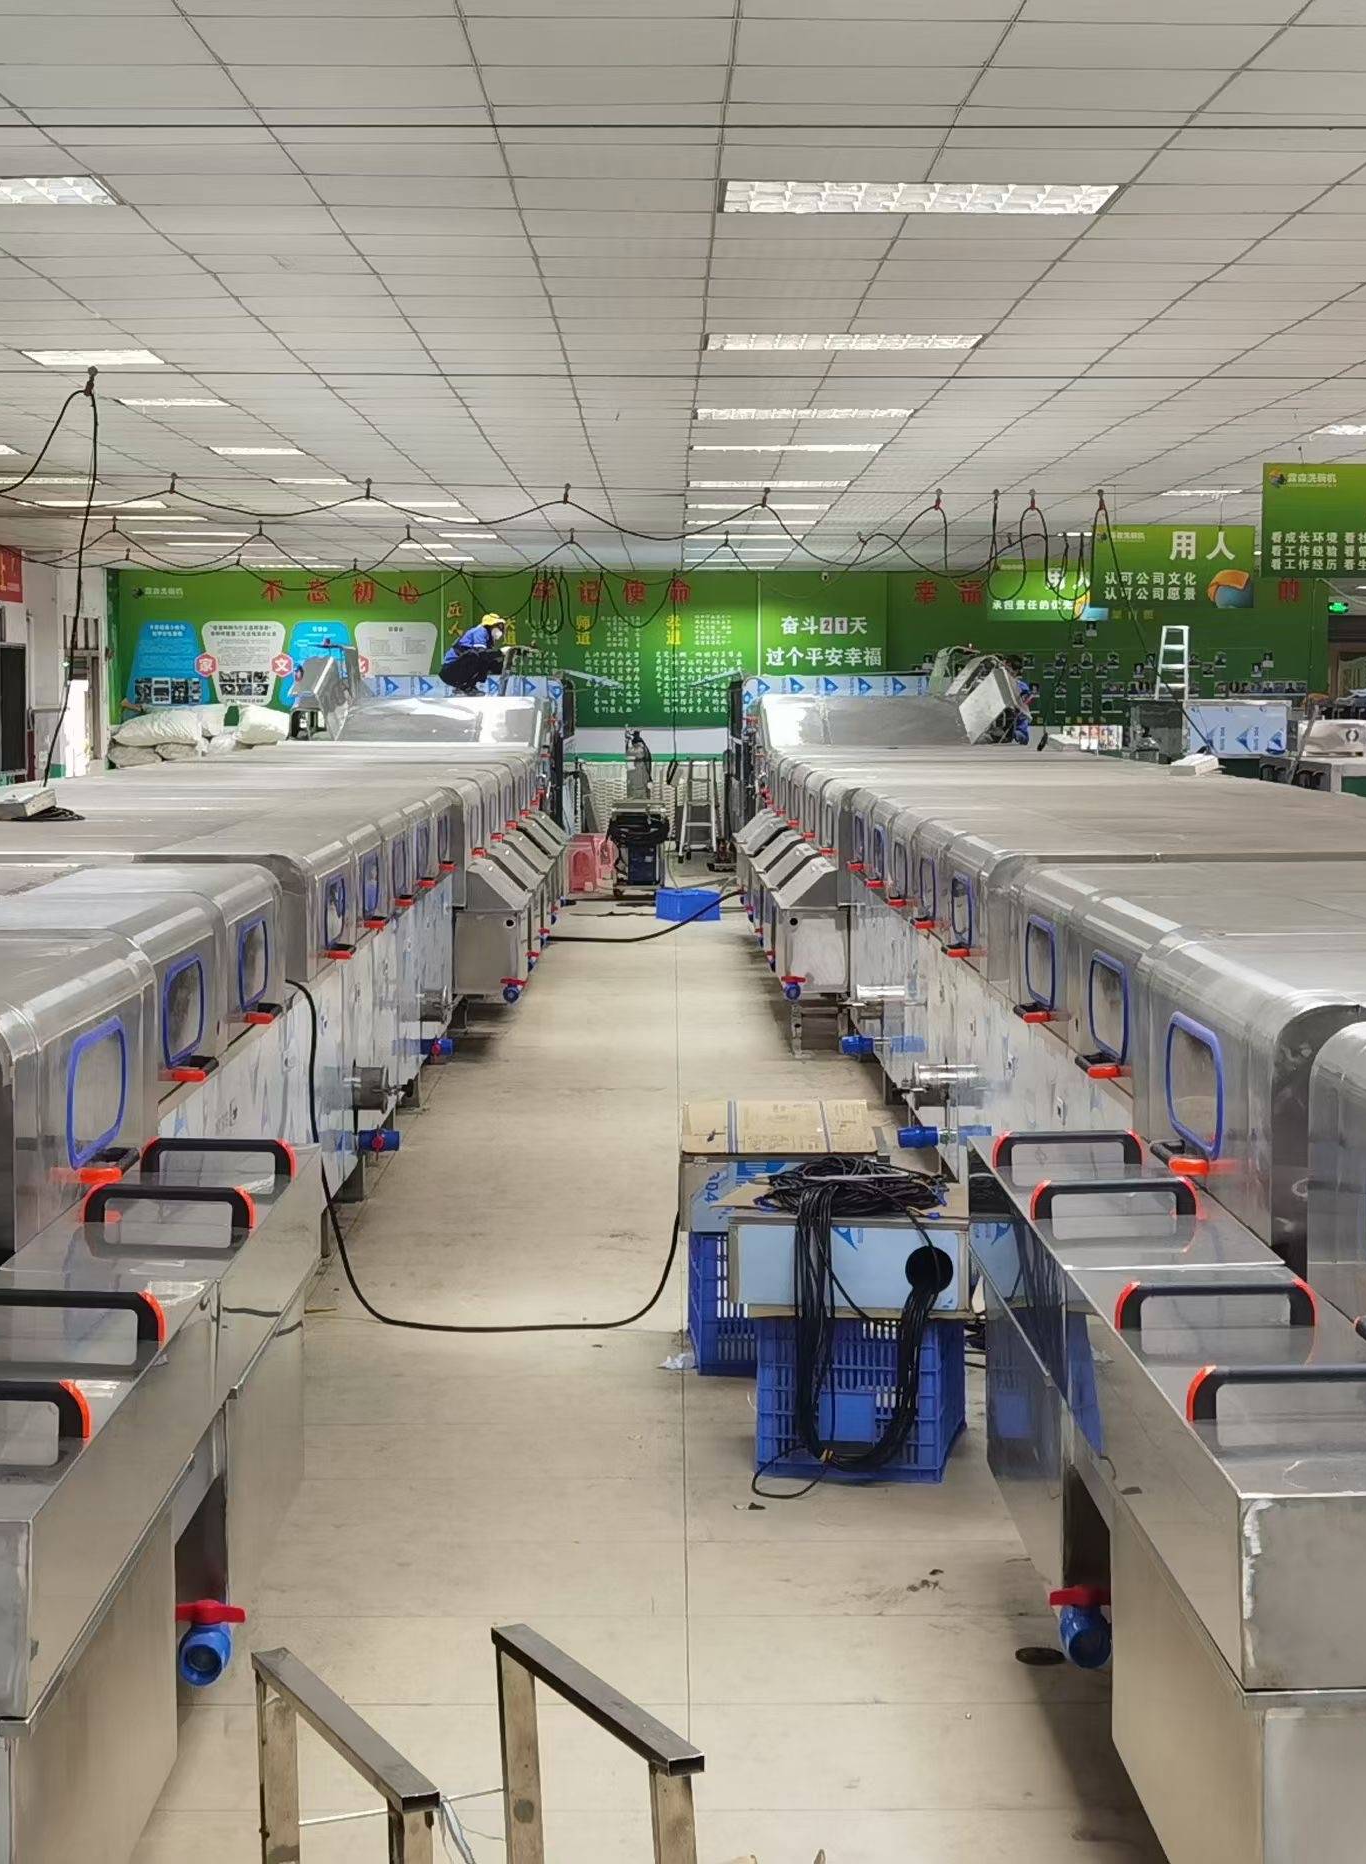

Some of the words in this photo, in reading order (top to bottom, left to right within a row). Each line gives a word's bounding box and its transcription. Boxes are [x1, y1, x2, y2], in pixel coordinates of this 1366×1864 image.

[1271, 531, 1338, 544] 看成长环境
[1170, 531, 1235, 560] 用人
[1271, 545, 1338, 557] 看工作经验
[1271, 559, 1337, 571] 看工作经历
[1104, 572, 1197, 586] 认可公司文化
[263, 578, 420, 604] 不忘初心
[916, 580, 985, 605] 幸福
[1104, 587, 1197, 601] 认可公司愿景
[765, 647, 882, 667] 过个平安幸福
[275, 659, 290, 672] 文
